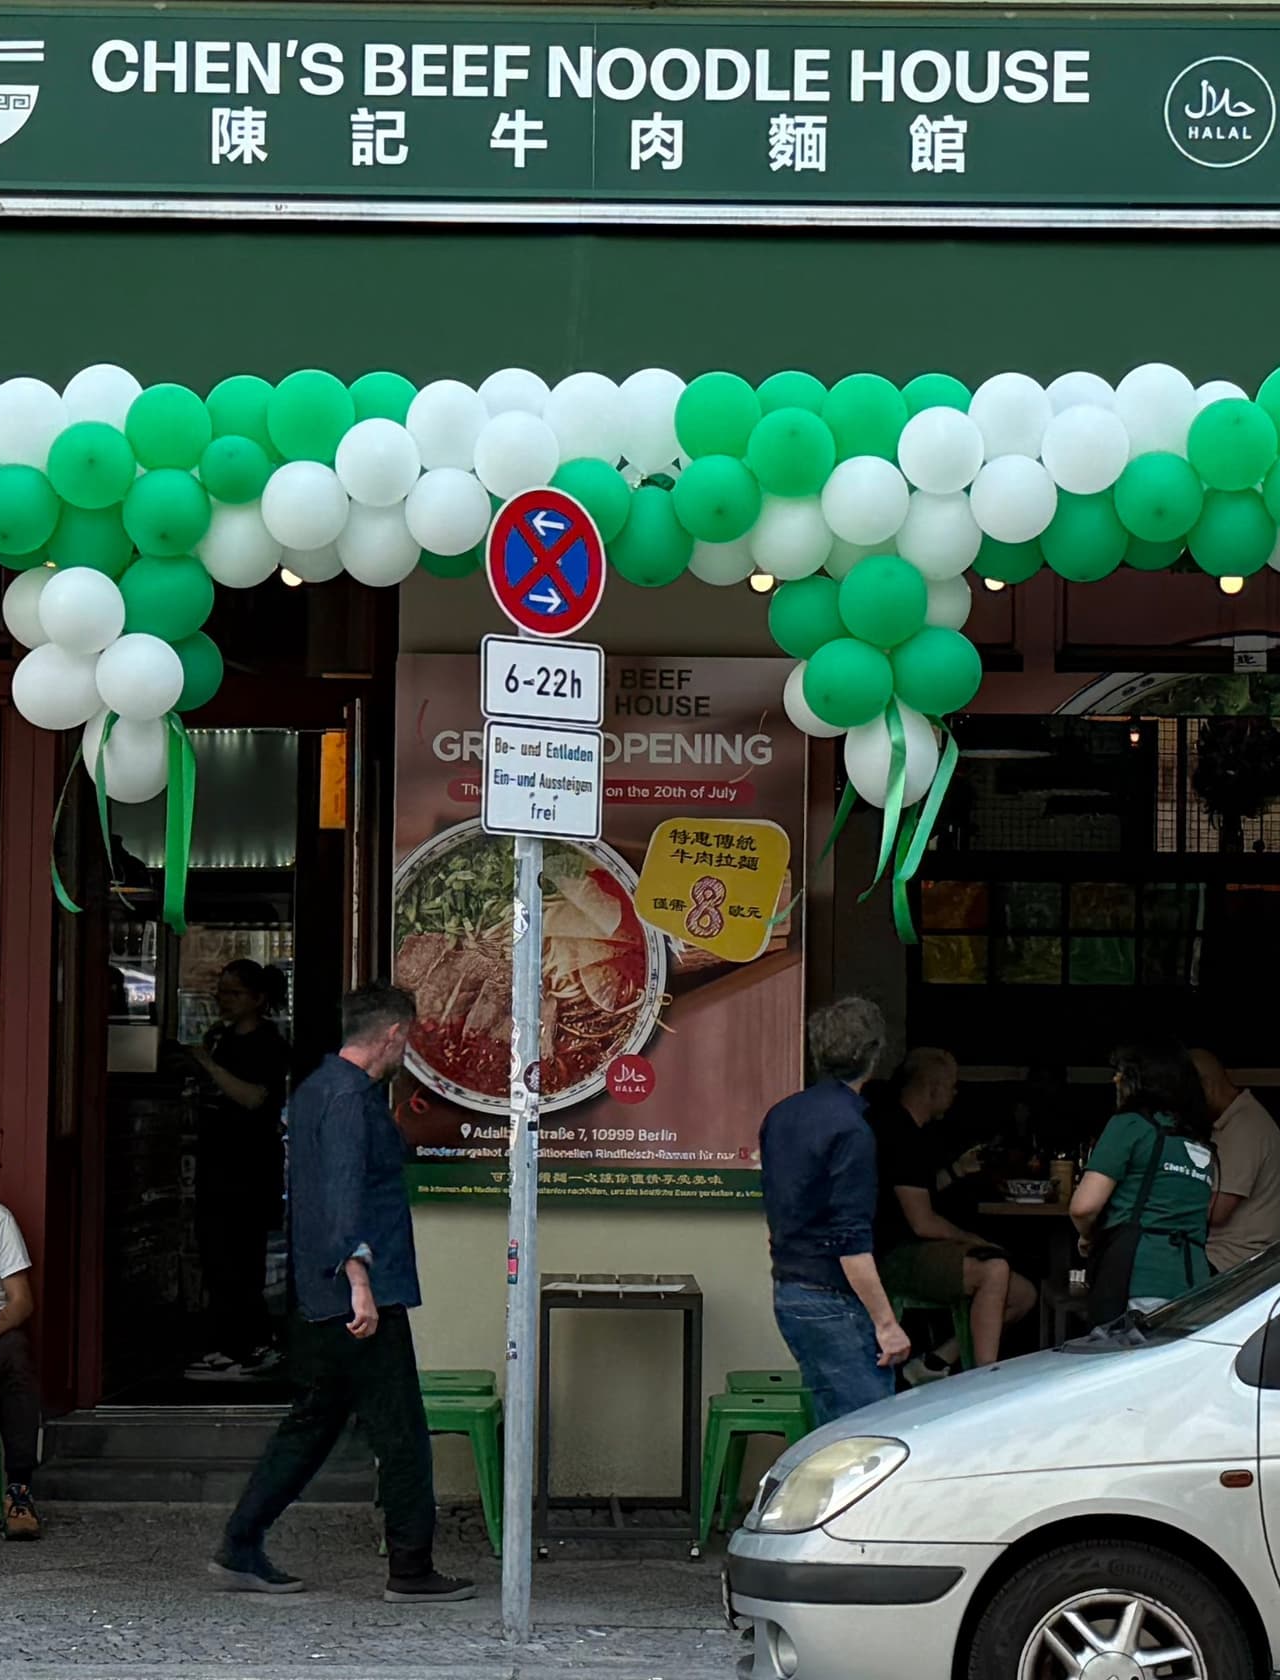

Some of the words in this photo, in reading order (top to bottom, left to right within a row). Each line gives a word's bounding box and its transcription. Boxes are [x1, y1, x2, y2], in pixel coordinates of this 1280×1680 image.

[91, 39, 345, 96] CHEN'S
[363, 43, 531, 98] BEEF
[547, 45, 832, 103] NOODLE
[849, 49, 1091, 104] HOUSE
[1184, 79, 1256, 119] حلال
[1188, 126, 1252, 140] HALAL
[620, 668, 693, 690] BEEF
[614, 695, 711, 718] HOUSE
[521, 741, 542, 757] und
[546, 742, 593, 762] Entladen
[603, 732, 773, 766] OPENING
[539, 773, 593, 796] Aussteigen
[606, 788, 623, 798] on
[627, 785, 650, 798] the
[654, 786, 687, 799] 20th
[690, 786, 705, 799] of
[707, 786, 738, 802] July
[531, 803, 557, 821] frei
[684, 875, 728, 939] 8
[592, 1128, 635, 1142] 10999
[638, 1129, 678, 1142] Berlin
